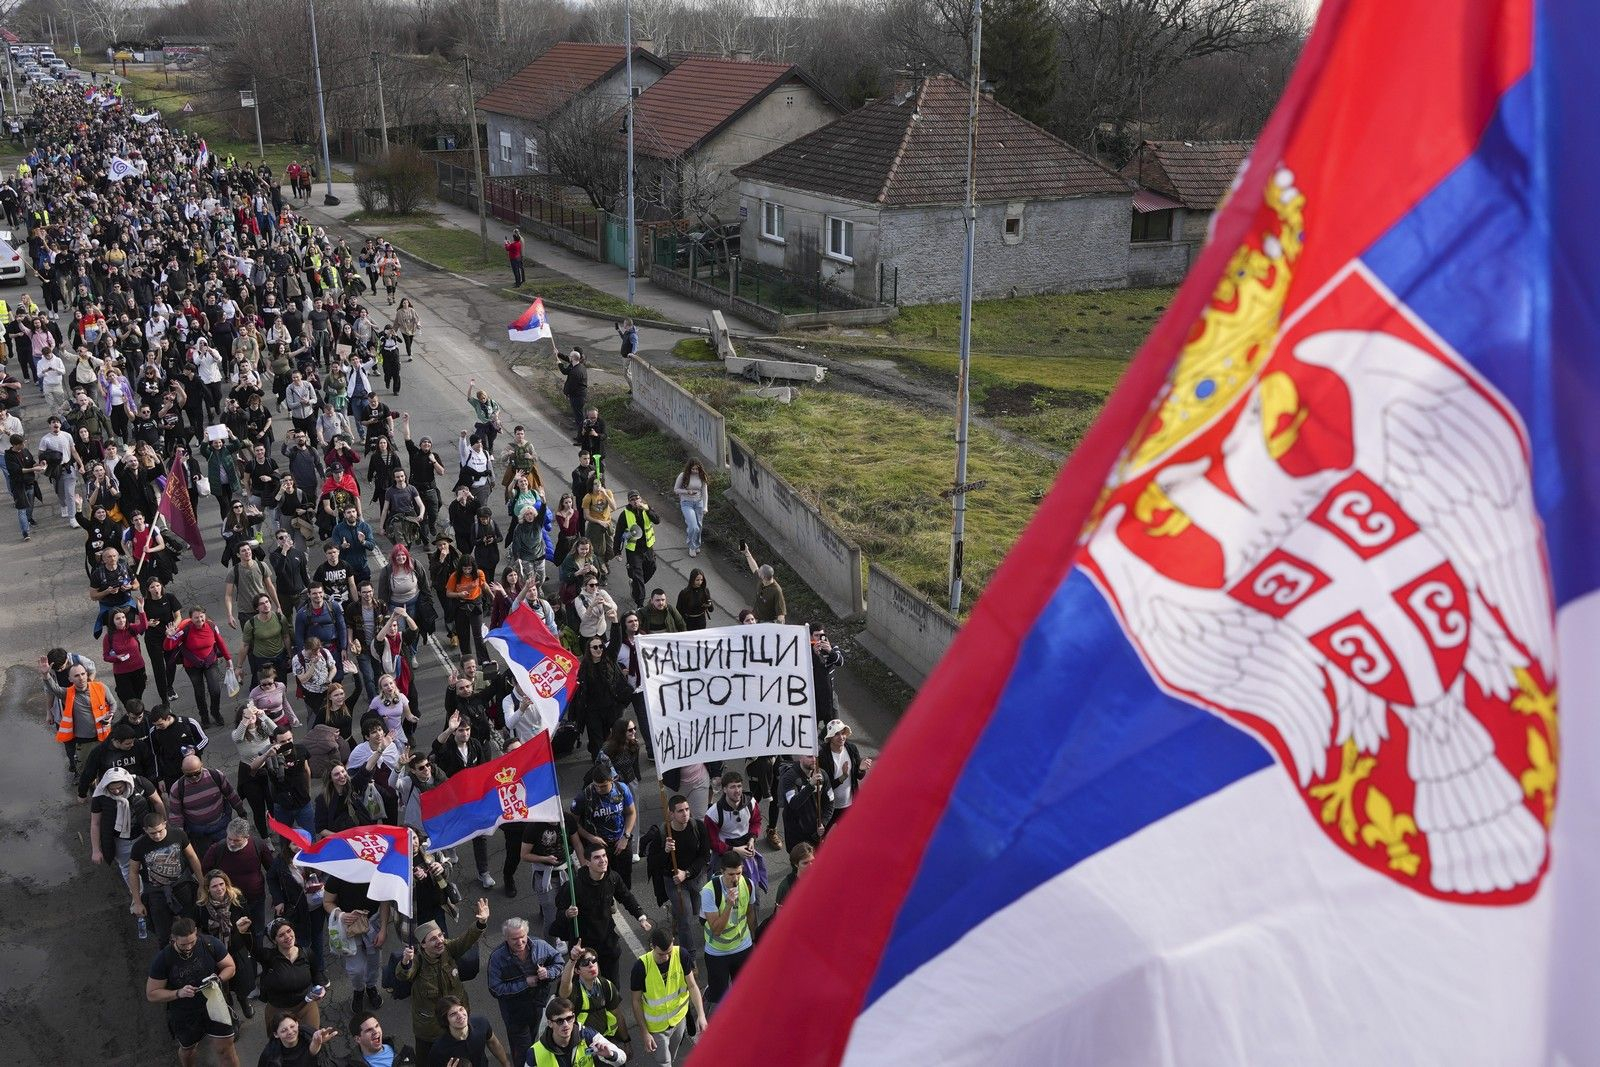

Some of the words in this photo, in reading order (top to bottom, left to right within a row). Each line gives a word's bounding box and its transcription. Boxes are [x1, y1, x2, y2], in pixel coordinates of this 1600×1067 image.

[324, 568, 347, 581] JONES
[641, 633, 799, 679] МАШИНЦИ
[658, 673, 809, 717] ПРОТИВ
[112, 756, 136, 768] ICON
[593, 802, 624, 818] ARILJE
